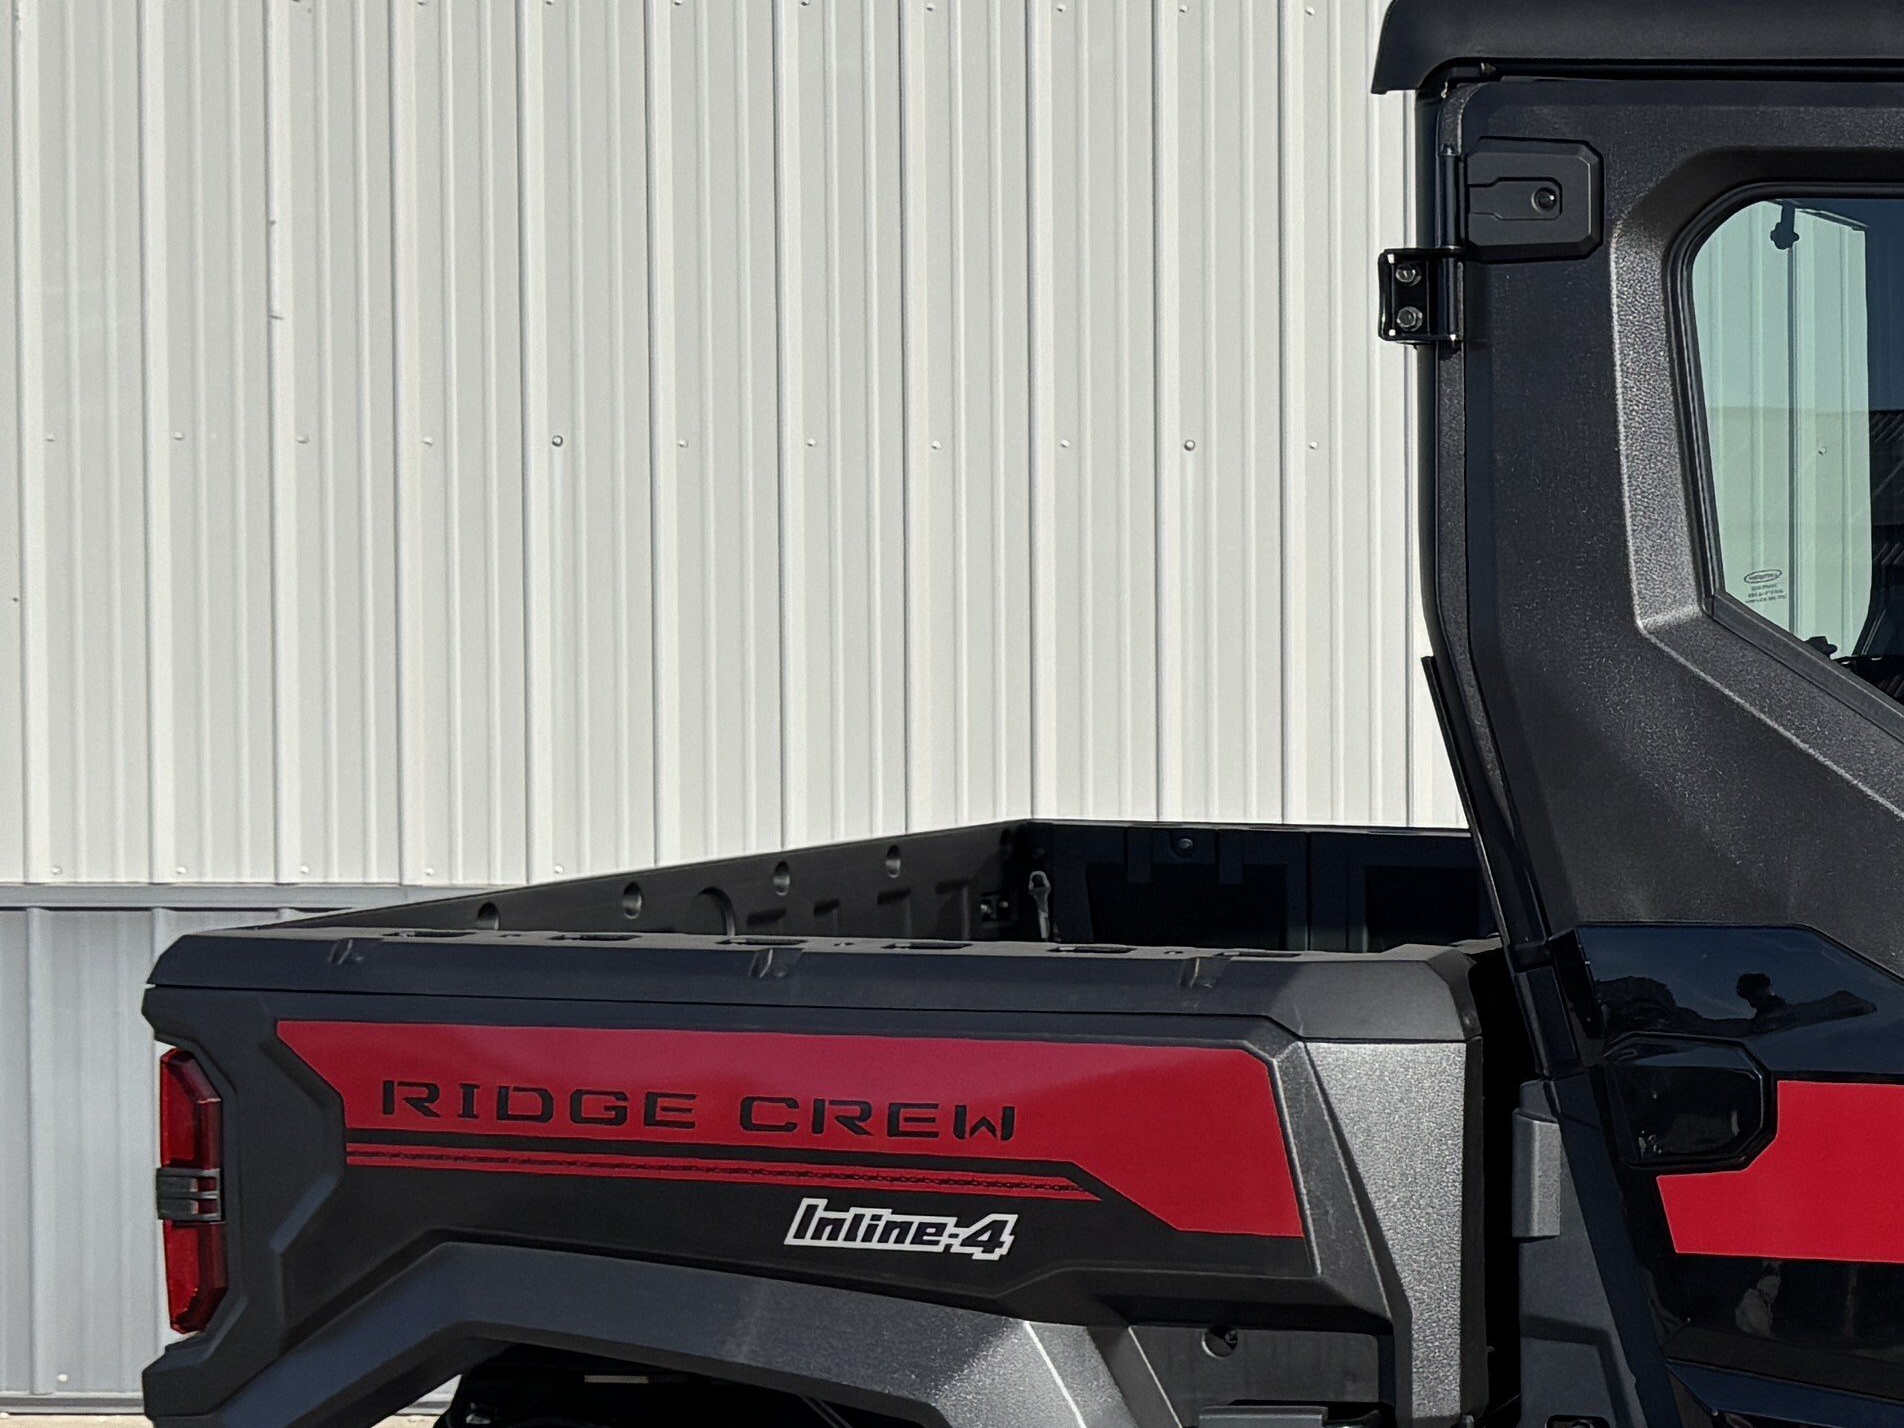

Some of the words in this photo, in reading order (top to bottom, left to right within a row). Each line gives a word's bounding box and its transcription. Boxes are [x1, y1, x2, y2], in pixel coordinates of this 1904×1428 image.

[382, 1078, 699, 1130] RIDGE
[738, 1094, 1016, 1142] CREW
[784, 1197, 1019, 1261] Inline-4
